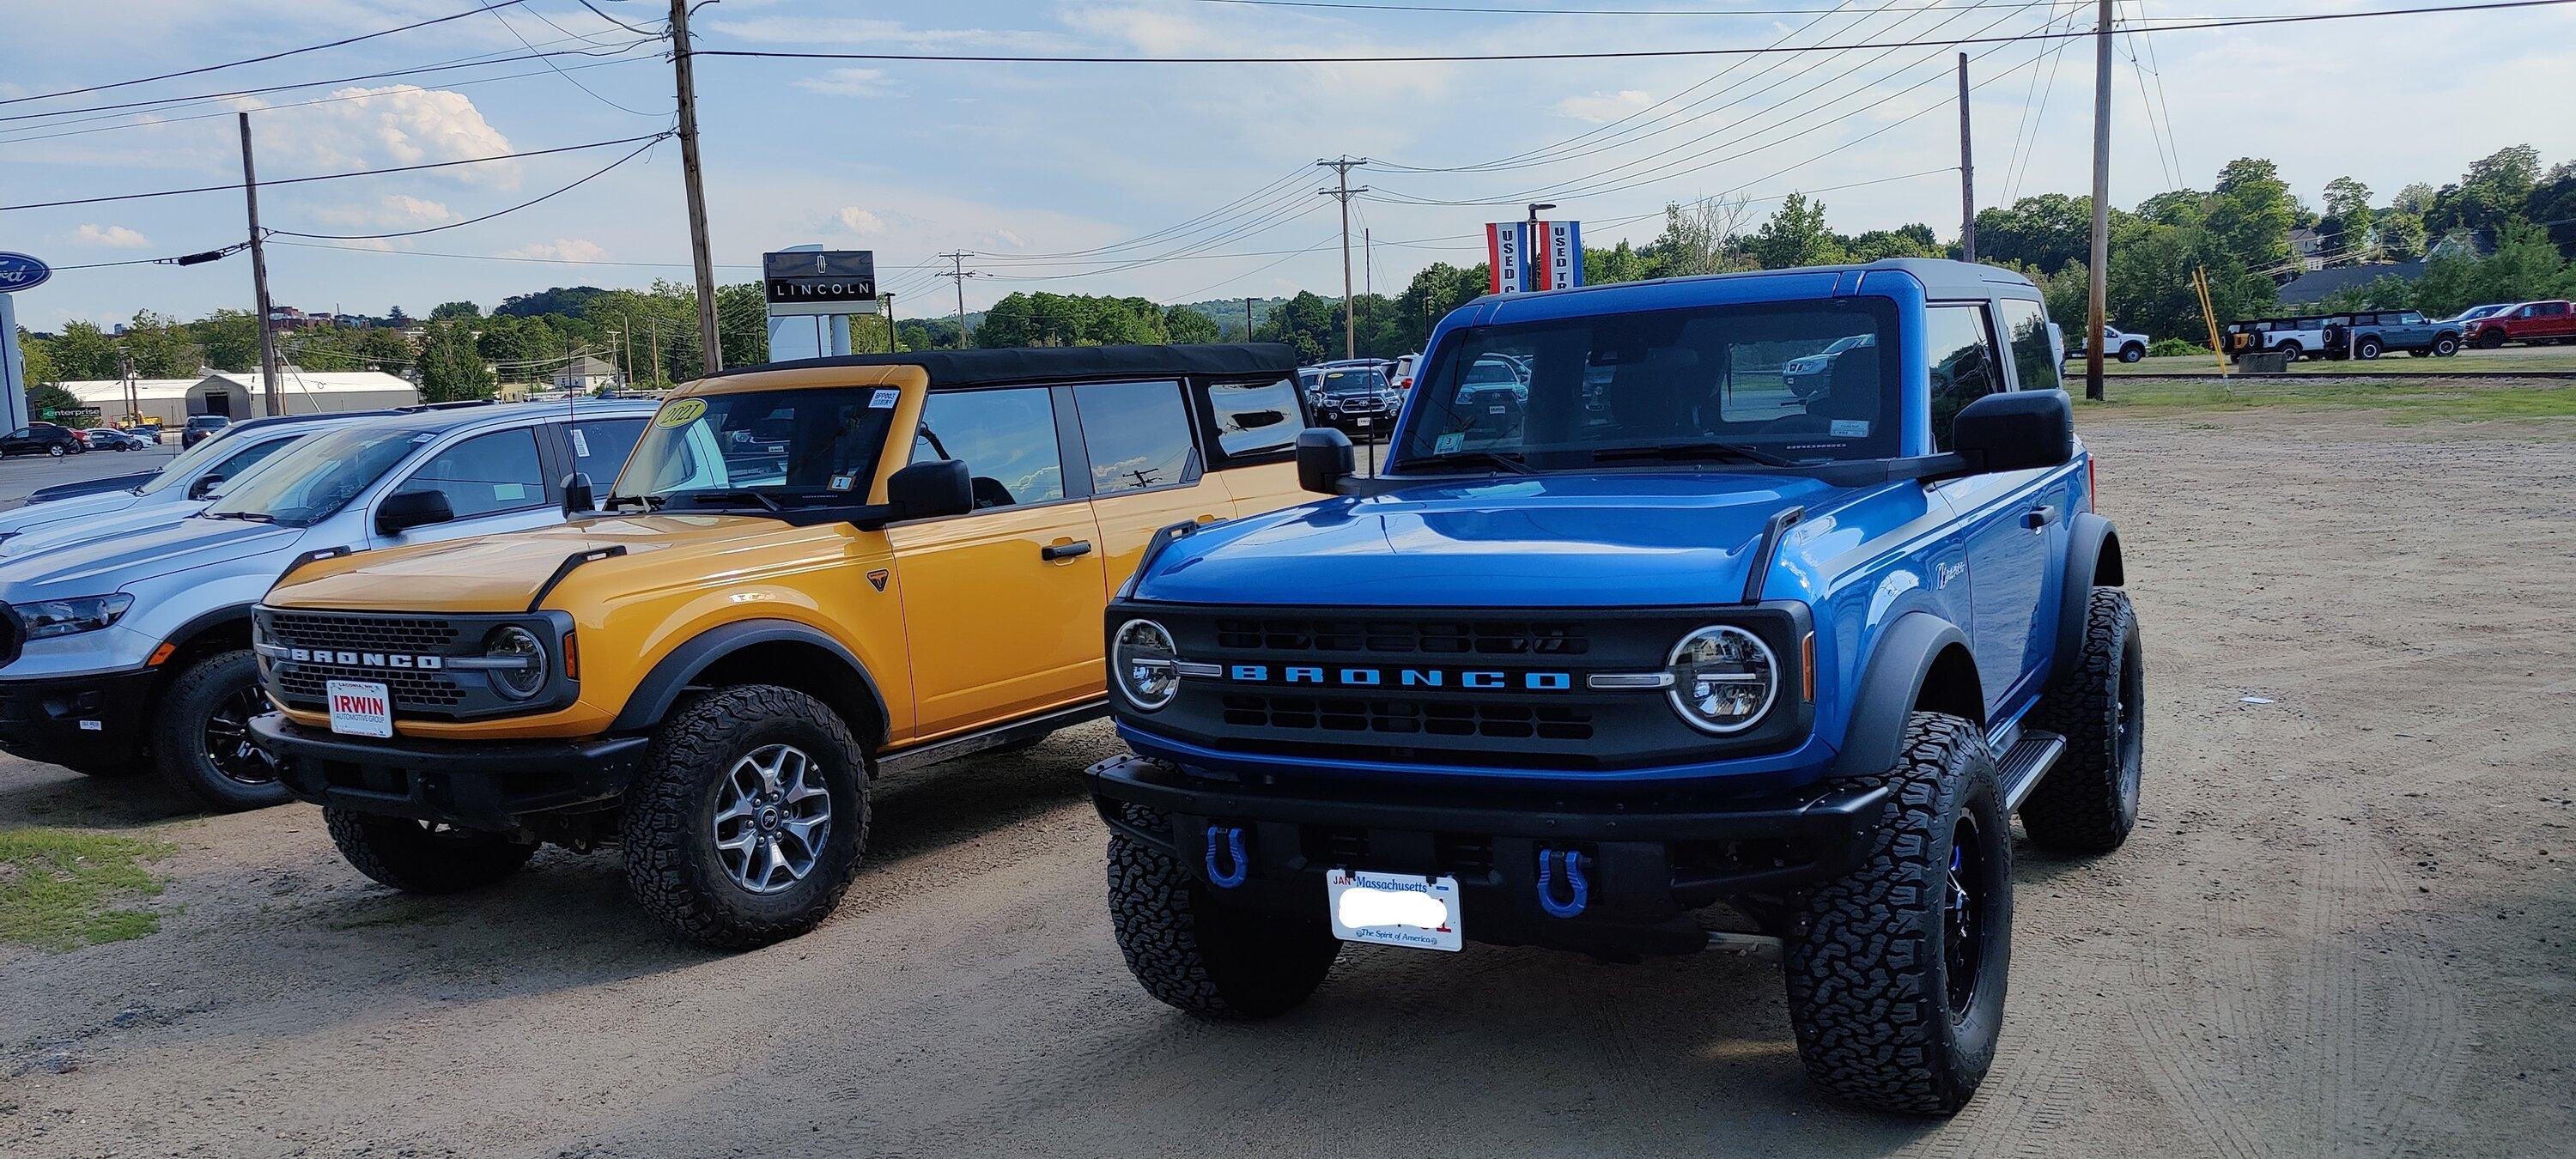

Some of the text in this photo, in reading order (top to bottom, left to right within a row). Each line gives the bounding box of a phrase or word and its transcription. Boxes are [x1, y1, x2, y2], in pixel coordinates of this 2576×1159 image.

[1502, 230, 1515, 279] USED
[1554, 227, 1567, 267] USED
[776, 282, 869, 295] LINCOLN
[43, 408, 100, 417] enterprise
[659, 403, 702, 424] 2021
[835, 478, 842, 487] 1
[291, 648, 441, 669] BRONCO
[1231, 664, 1571, 689] BRONCO
[334, 695, 384, 716] IRWIN
[336, 713, 368, 722] AUTOMOTIVE
[1333, 876, 1352, 886] JAN
[1356, 876, 1428, 893] Massachusetts
[1361, 928, 1431, 944] The Spirit of America
